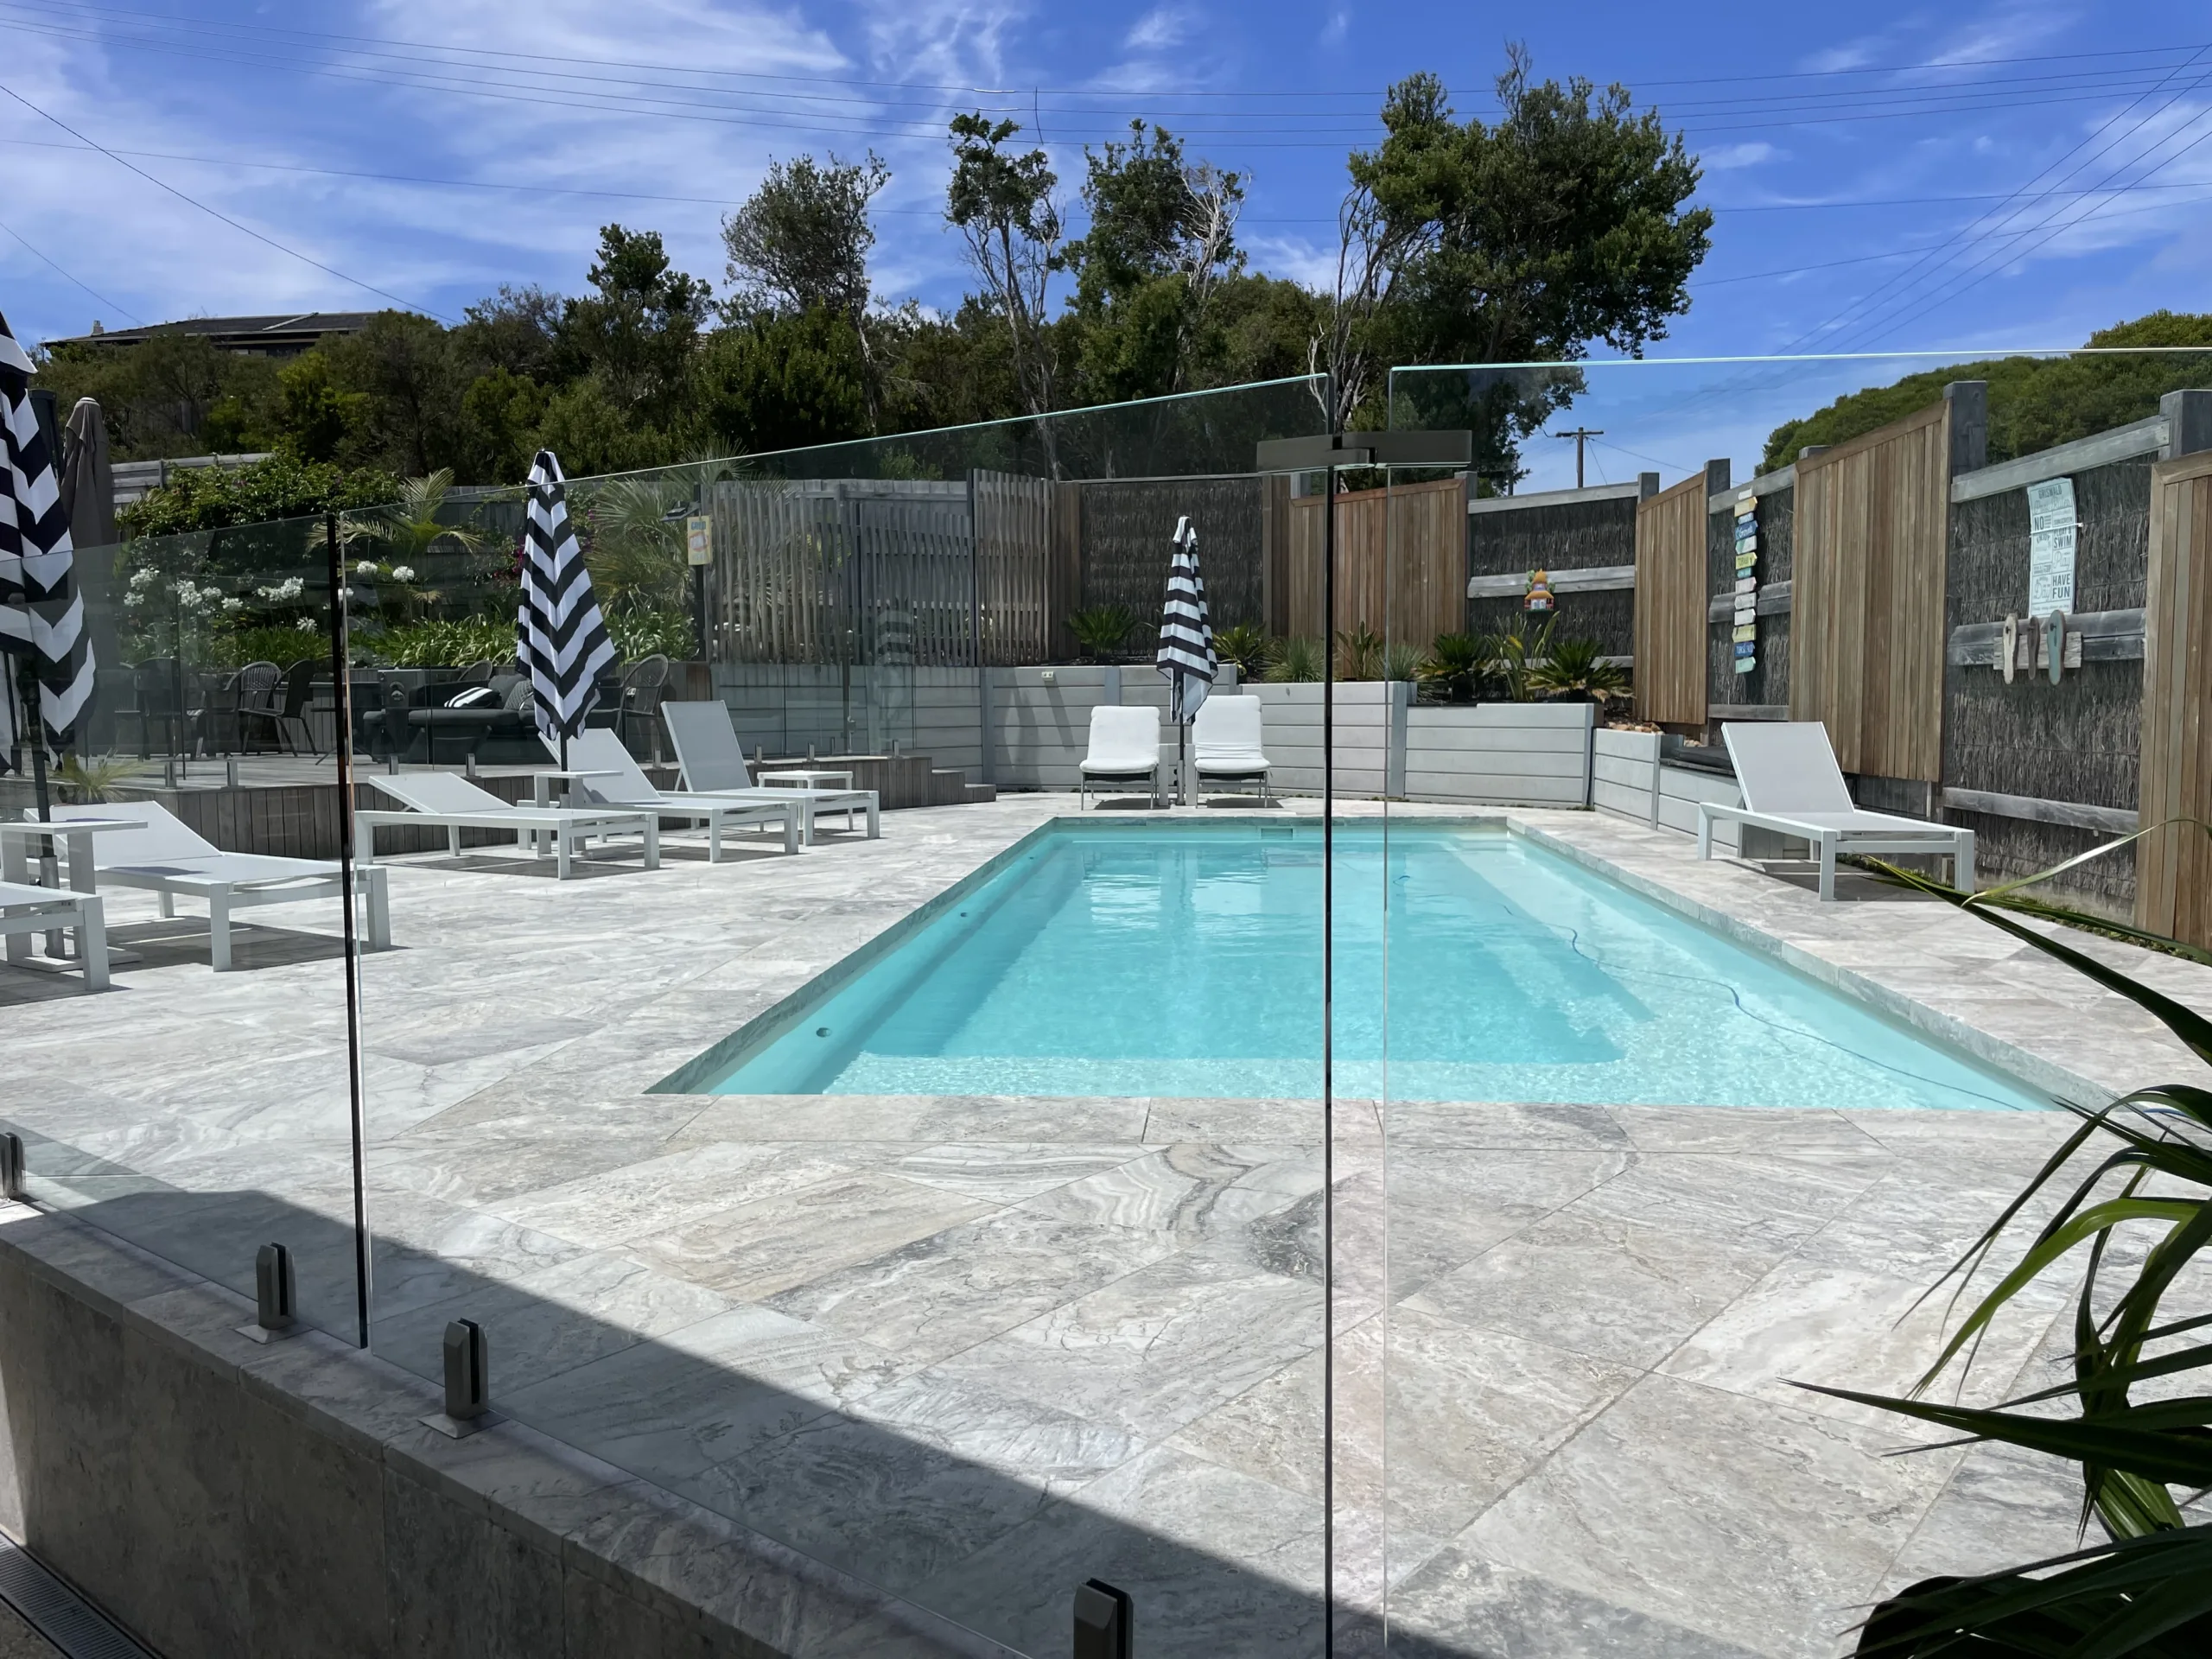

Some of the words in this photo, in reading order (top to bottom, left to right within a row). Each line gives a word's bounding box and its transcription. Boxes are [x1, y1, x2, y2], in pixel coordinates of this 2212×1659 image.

[2034, 516, 2044, 531] NO
[2054, 535, 2072, 549] SWIM
[2053, 573, 2070, 587] HAVE
[2053, 587, 2070, 600] FUN
